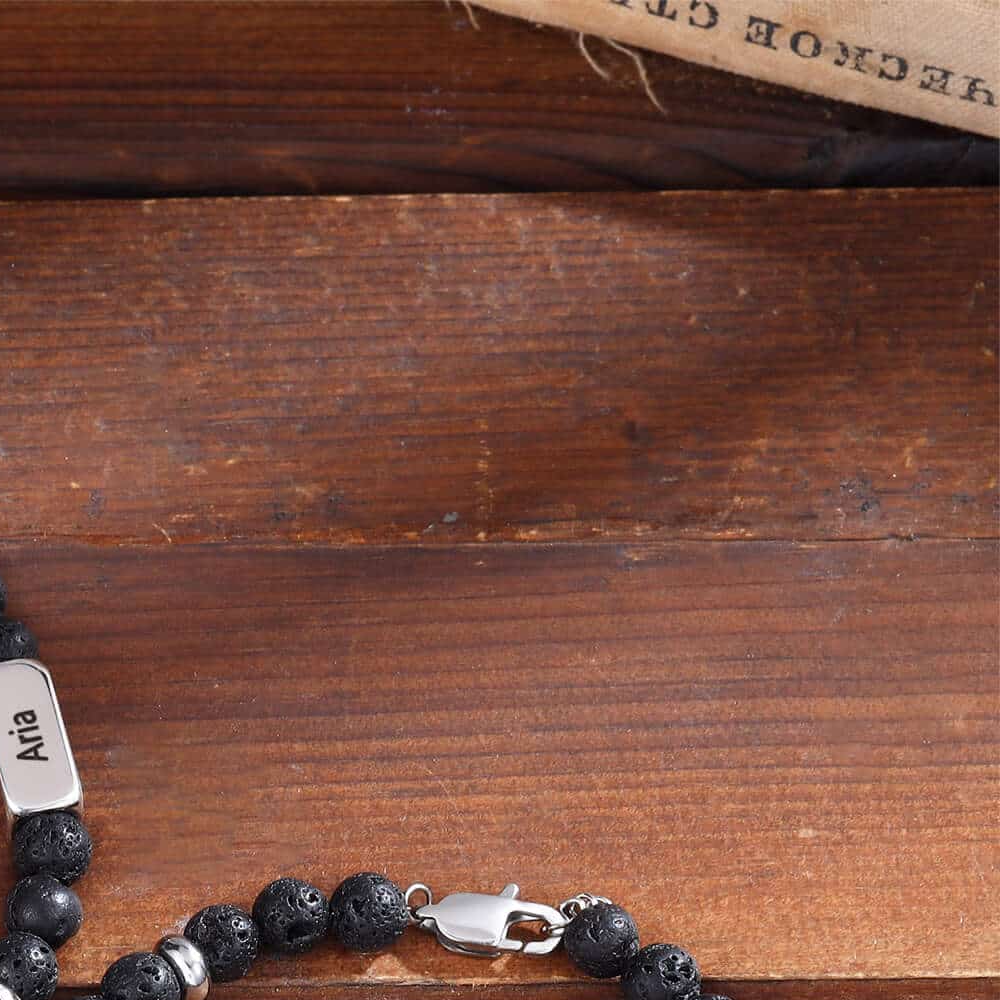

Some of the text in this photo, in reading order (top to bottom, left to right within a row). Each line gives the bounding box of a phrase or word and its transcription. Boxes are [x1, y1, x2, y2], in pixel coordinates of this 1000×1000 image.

[609, 0, 998, 107] ЧЕСКОЕ СТ
[8, 709, 49, 761] Aria
